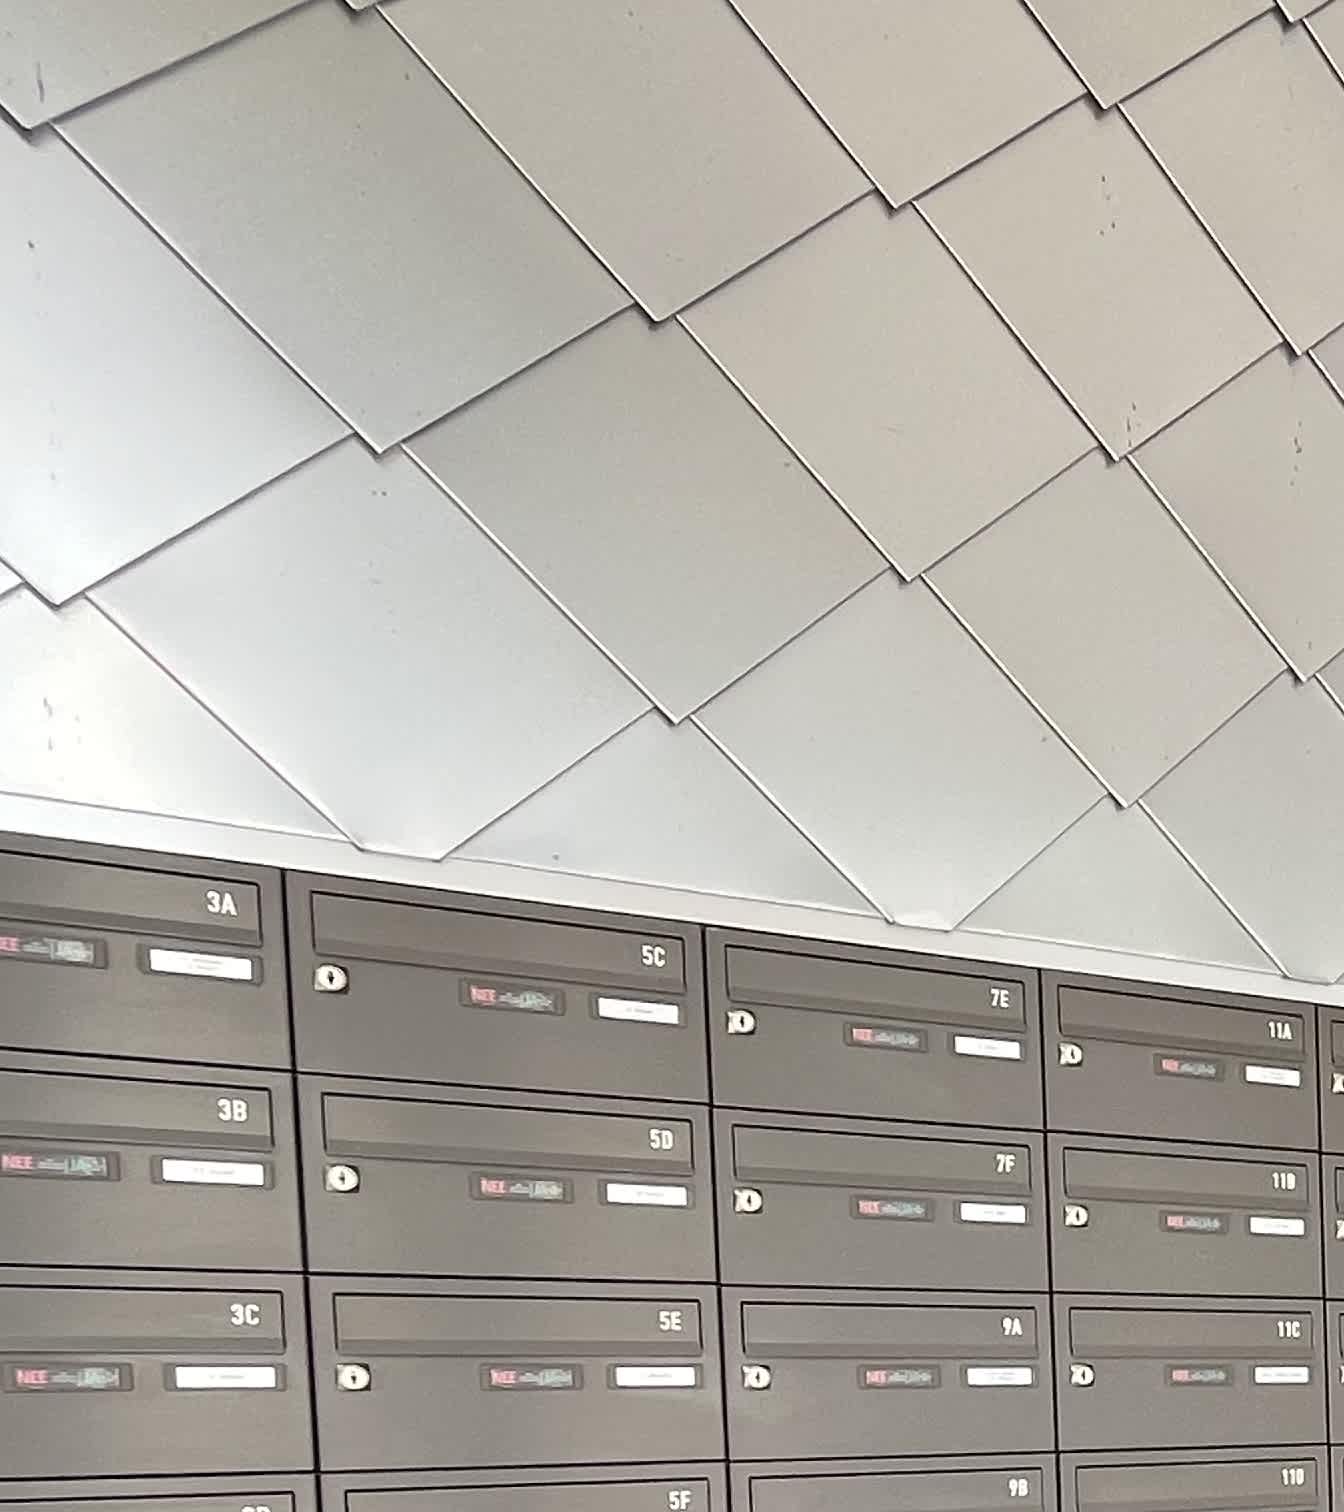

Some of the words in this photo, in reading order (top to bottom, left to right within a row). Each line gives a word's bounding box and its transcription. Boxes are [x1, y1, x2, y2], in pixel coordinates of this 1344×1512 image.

[206, 890, 238, 916] 3A
[642, 945, 666, 967] 5C
[990, 988, 1009, 1008] 7E
[1268, 1021, 1293, 1040] 11A
[217, 1098, 247, 1122] 3B
[649, 1128, 673, 1150] 5D
[996, 1153, 1016, 1173] 7F
[230, 1303, 260, 1325] 3C
[659, 1310, 682, 1331] 5E
[1002, 1317, 1023, 1336] 9A
[1277, 1320, 1301, 1338] 11C
[1009, 1478, 1028, 1497] 9B
[669, 1490, 691, 1510] 5F
